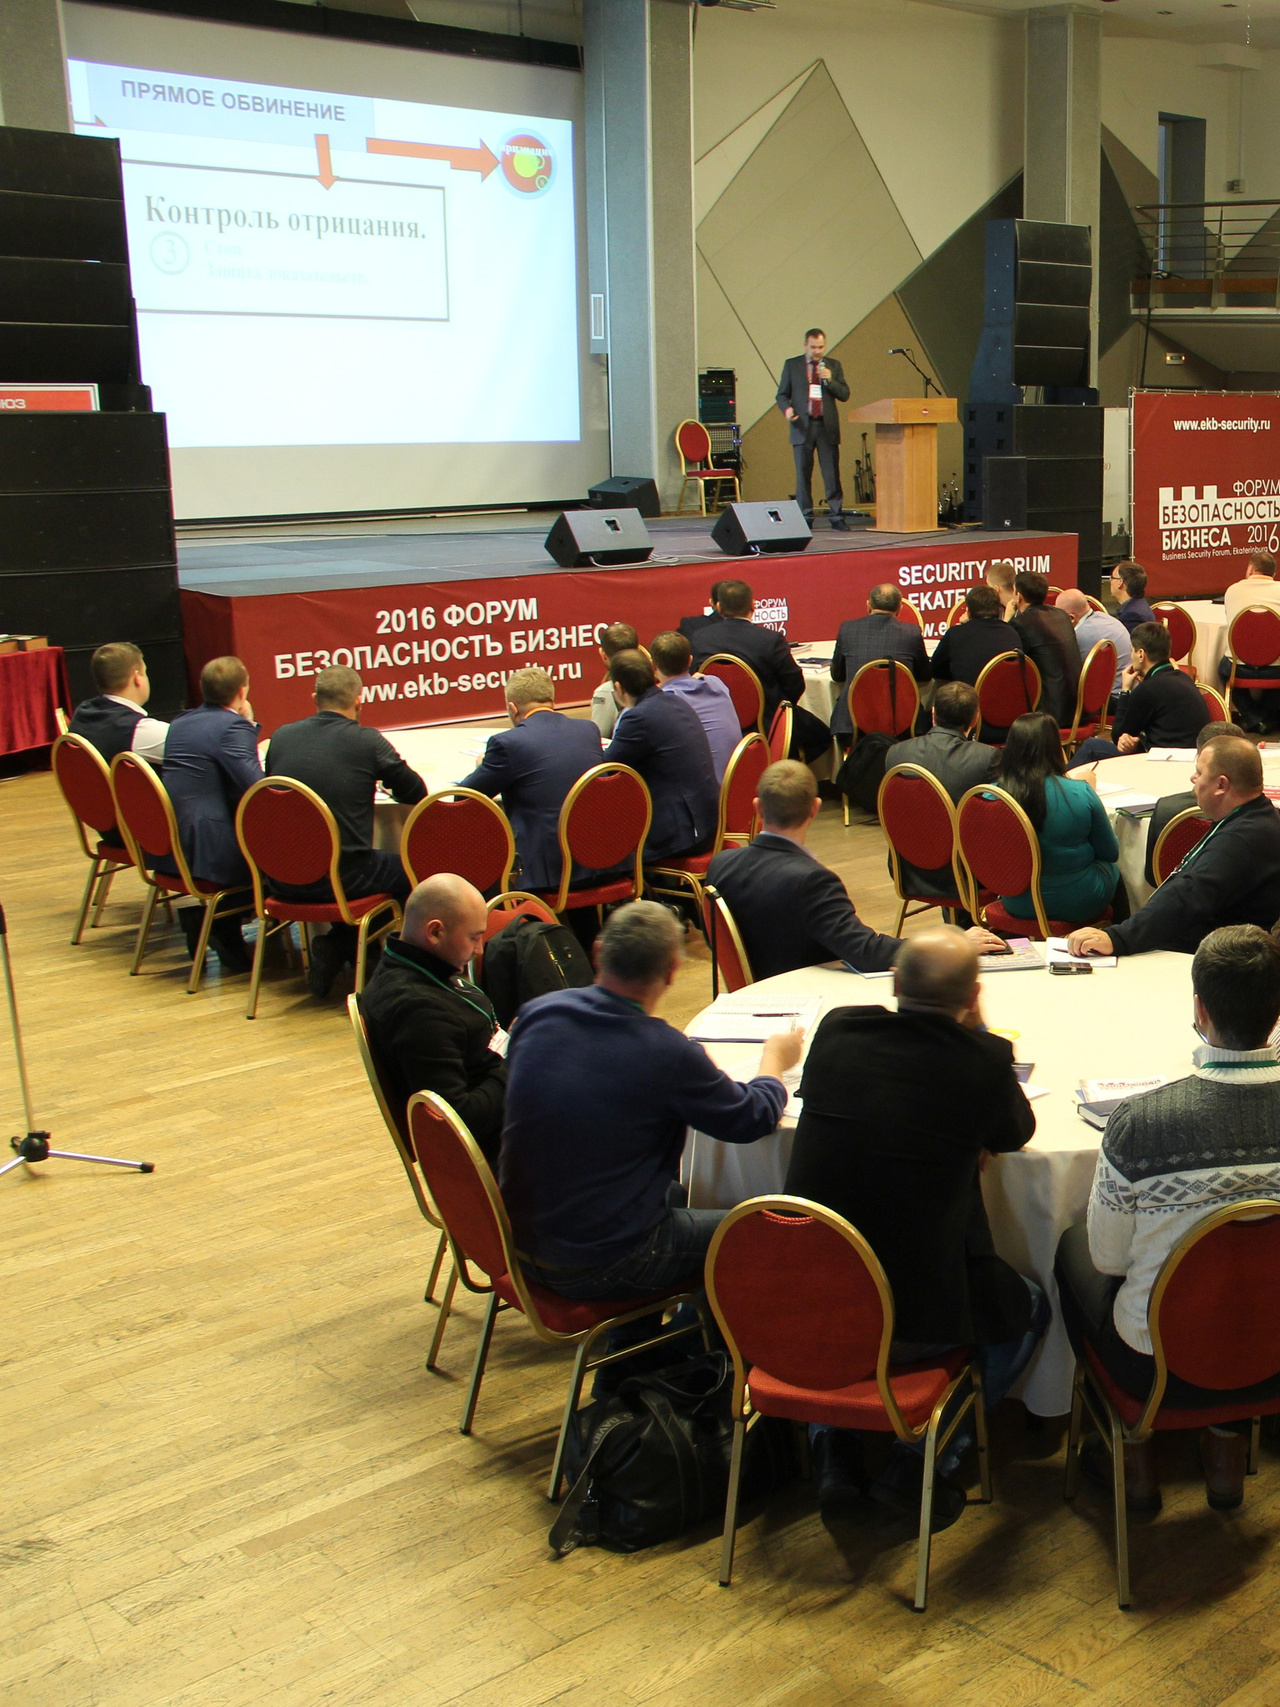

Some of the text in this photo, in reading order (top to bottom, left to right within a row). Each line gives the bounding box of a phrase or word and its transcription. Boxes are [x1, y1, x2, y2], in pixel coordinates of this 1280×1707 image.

[120, 79, 346, 122] ПРЯМОЕ ОБВИНЕНИЕ
[144, 195, 427, 240] Контроль отрицания.
[162, 238, 178, 265] 3
[1173, 417, 1271, 434] www.ekb-security.ru
[1162, 500, 1280, 525] БЕЗОПАСНОСТЬ
[1161, 524, 1280, 554] БИЗНЕСА 2016
[1161, 551, 1187, 561] Business
[1187, 549, 1211, 560] Security
[1232, 545, 1269, 556] Ekaterinburg
[898, 559, 987, 587] SECURITY
[375, 597, 539, 635] 2016 ФОРУМ
[754, 597, 787, 609] ФОРУМ
[274, 620, 621, 680] БЕЗОПАСНОСТЬ БИЗНЕС
